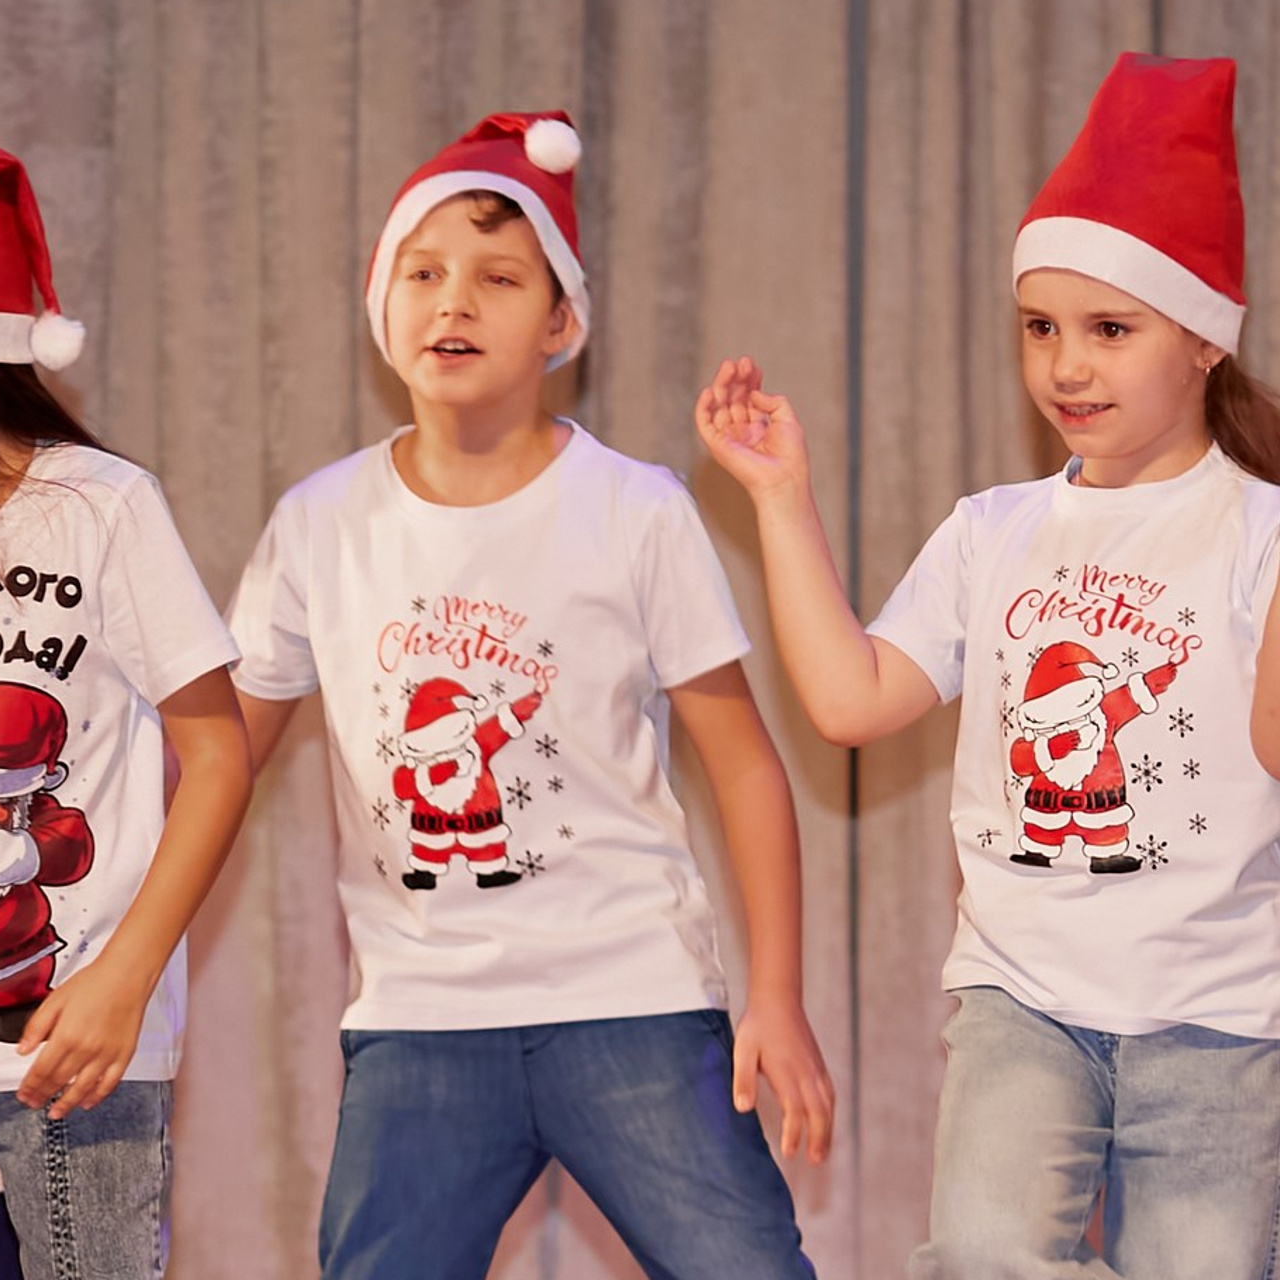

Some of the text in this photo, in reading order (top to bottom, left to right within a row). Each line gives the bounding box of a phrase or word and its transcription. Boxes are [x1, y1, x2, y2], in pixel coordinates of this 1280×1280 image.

[1073, 564, 1167, 606] Merry
[433, 595, 528, 638] Merry
[1005, 589, 1203, 665] Christmas
[377, 621, 559, 694] Christmas
